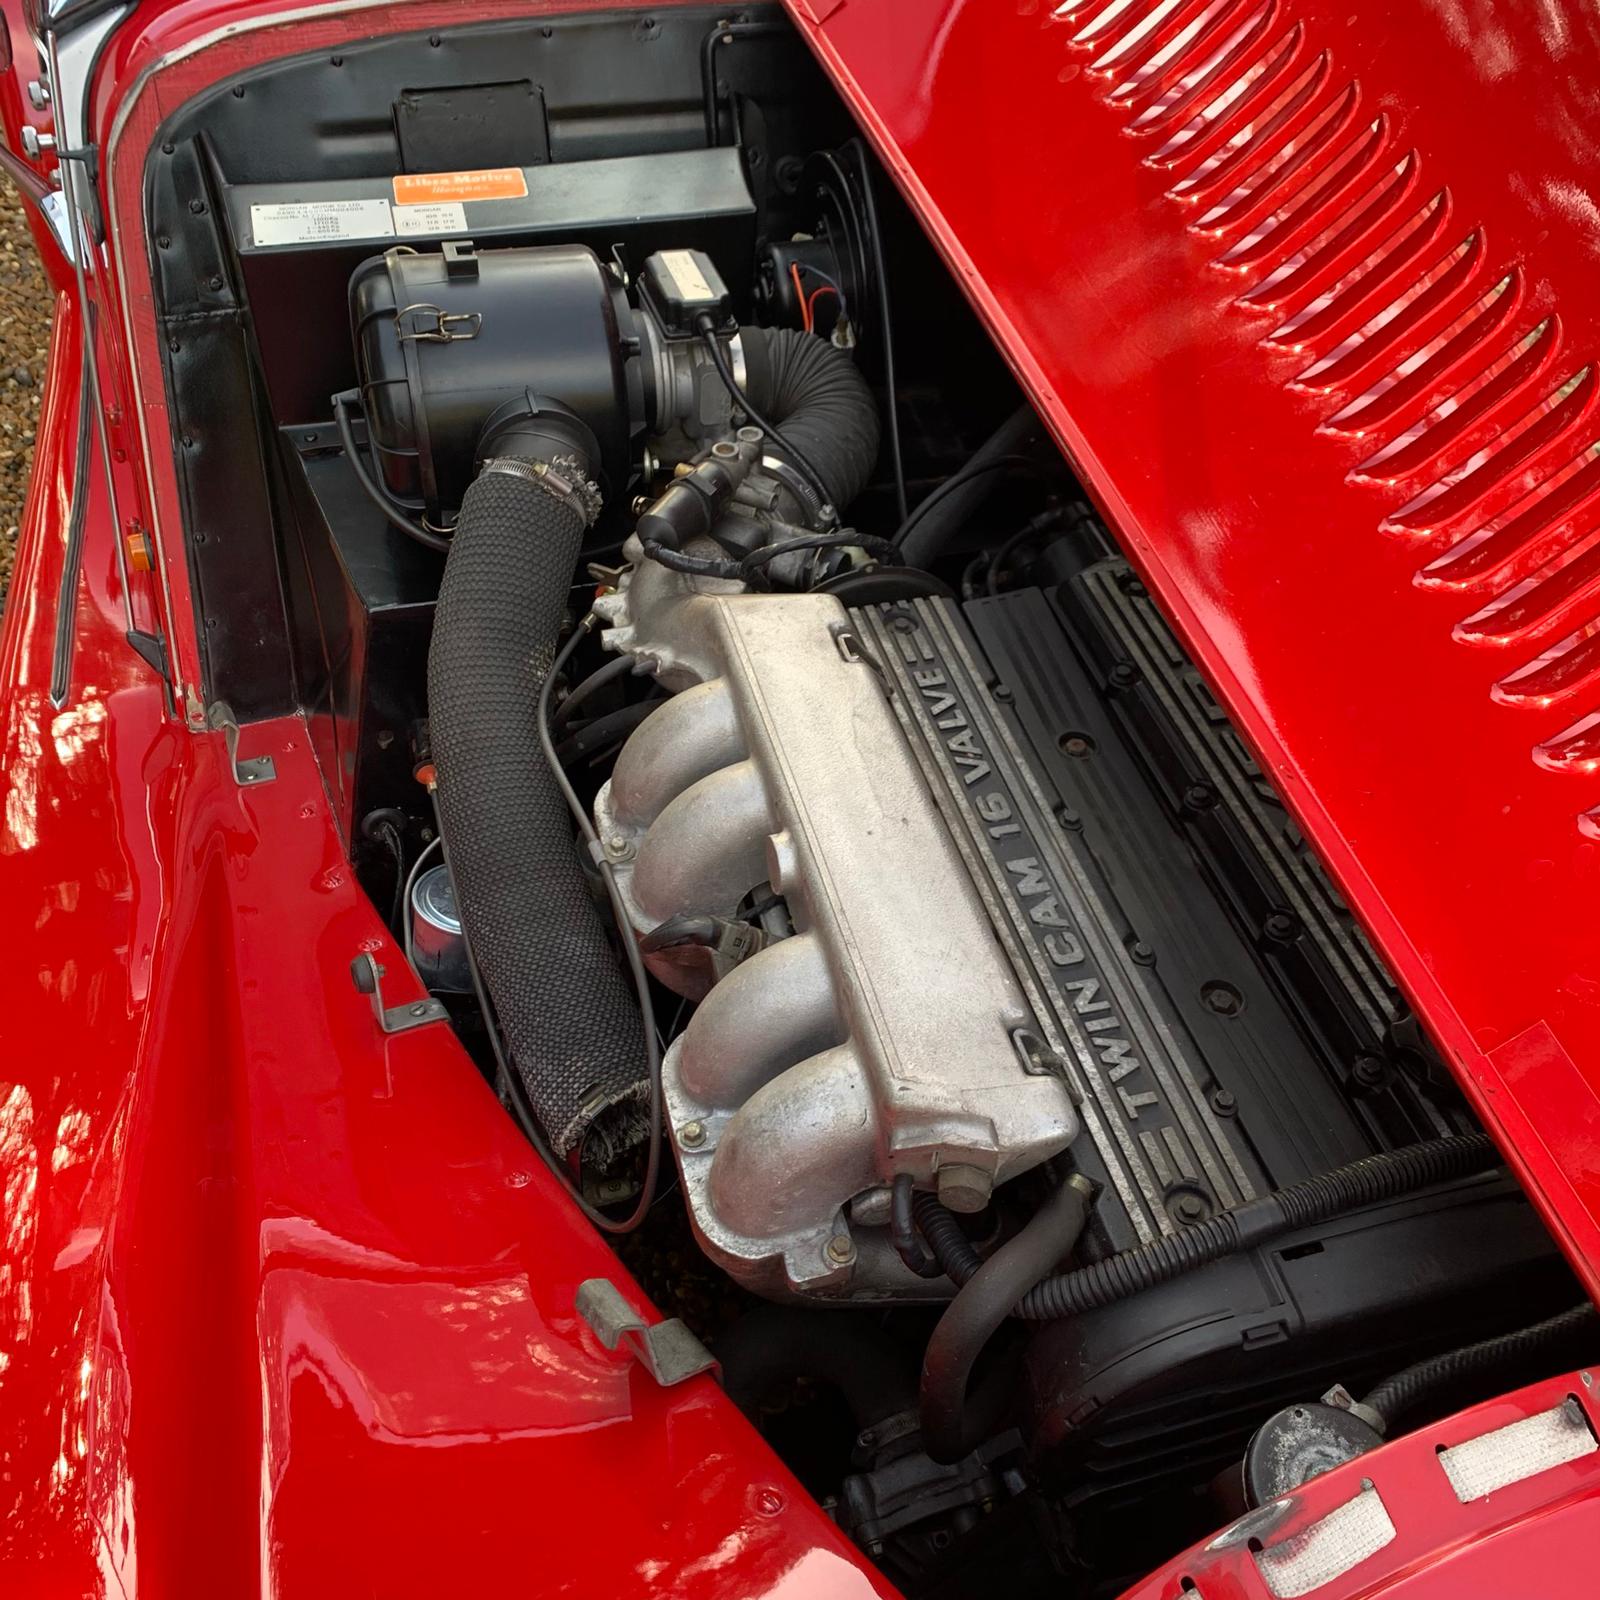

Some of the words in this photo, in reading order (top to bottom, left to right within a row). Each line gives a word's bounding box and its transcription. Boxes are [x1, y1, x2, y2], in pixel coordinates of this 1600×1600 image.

[913, 666, 992, 785] VALVE
[975, 790, 1022, 841] 16
[1006, 857, 1086, 969] CAM
[1063, 978, 1159, 1122] TWIN
